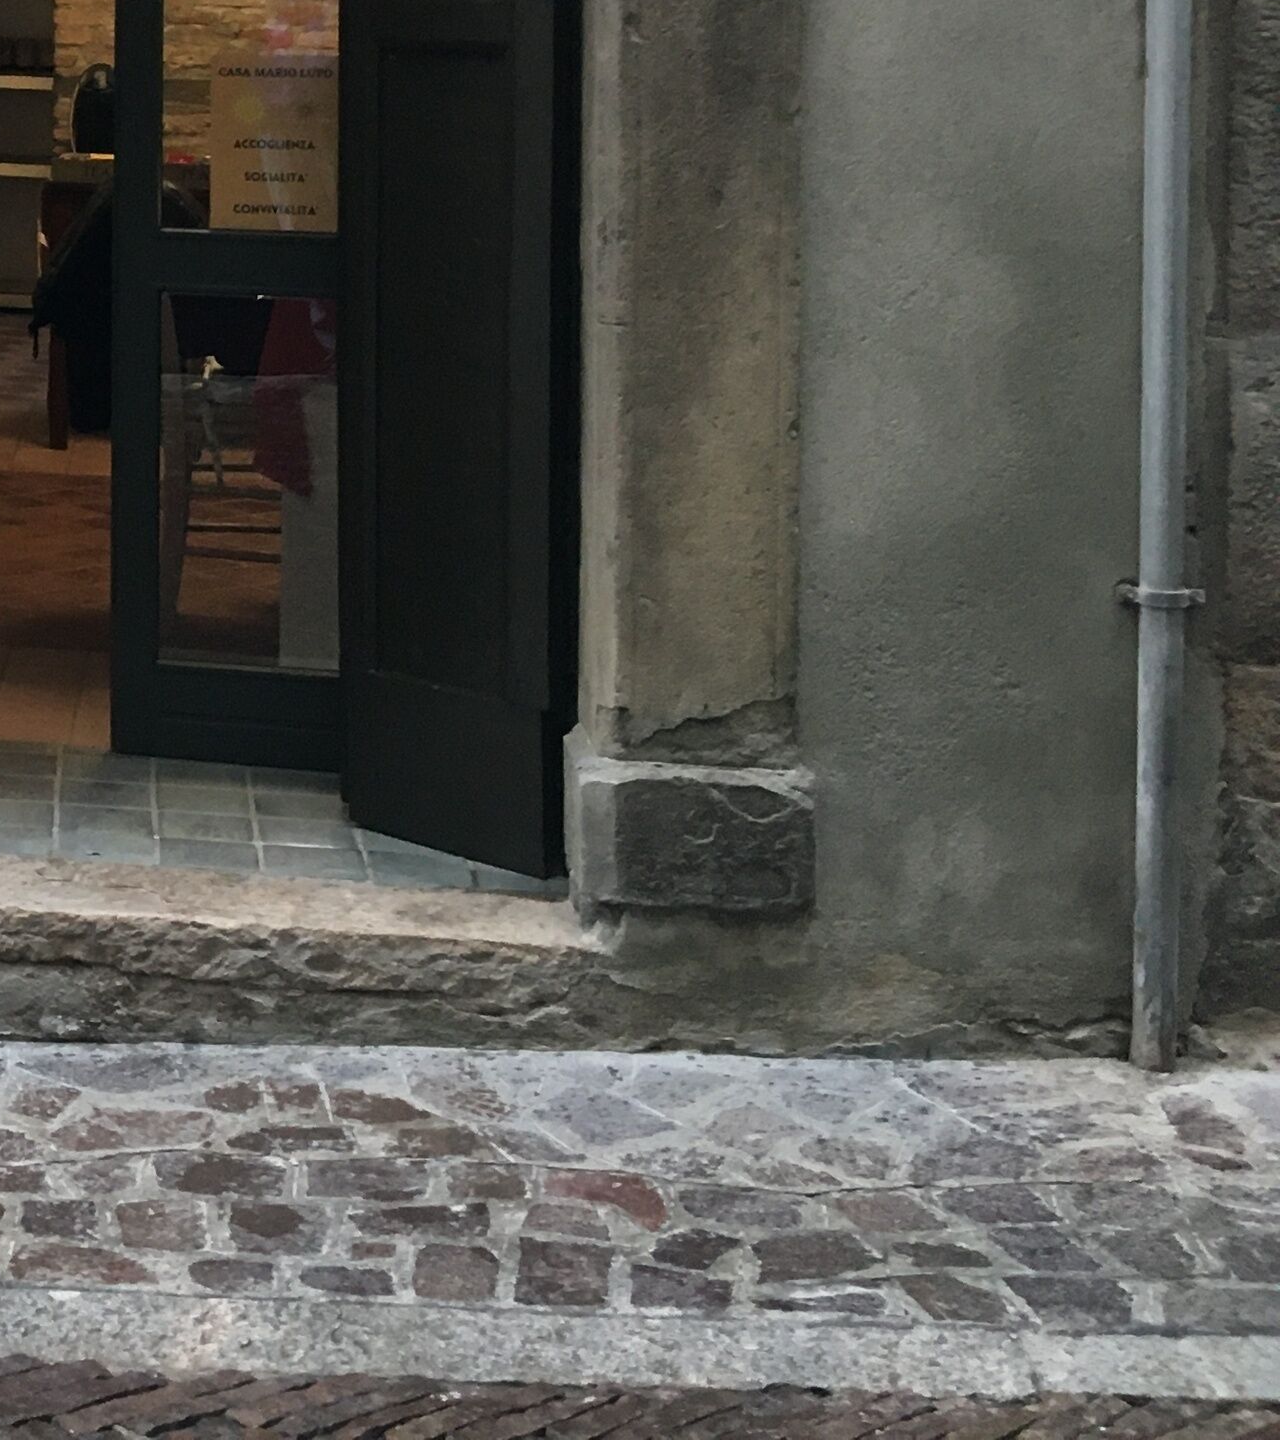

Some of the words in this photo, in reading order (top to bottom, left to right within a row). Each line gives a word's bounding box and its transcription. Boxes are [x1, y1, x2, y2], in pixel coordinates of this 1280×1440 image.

[218, 67, 251, 78] CASA
[254, 68, 298, 79] MARIO
[300, 68, 333, 79] LUPO
[233, 138, 315, 150] ACCOGLIENZA
